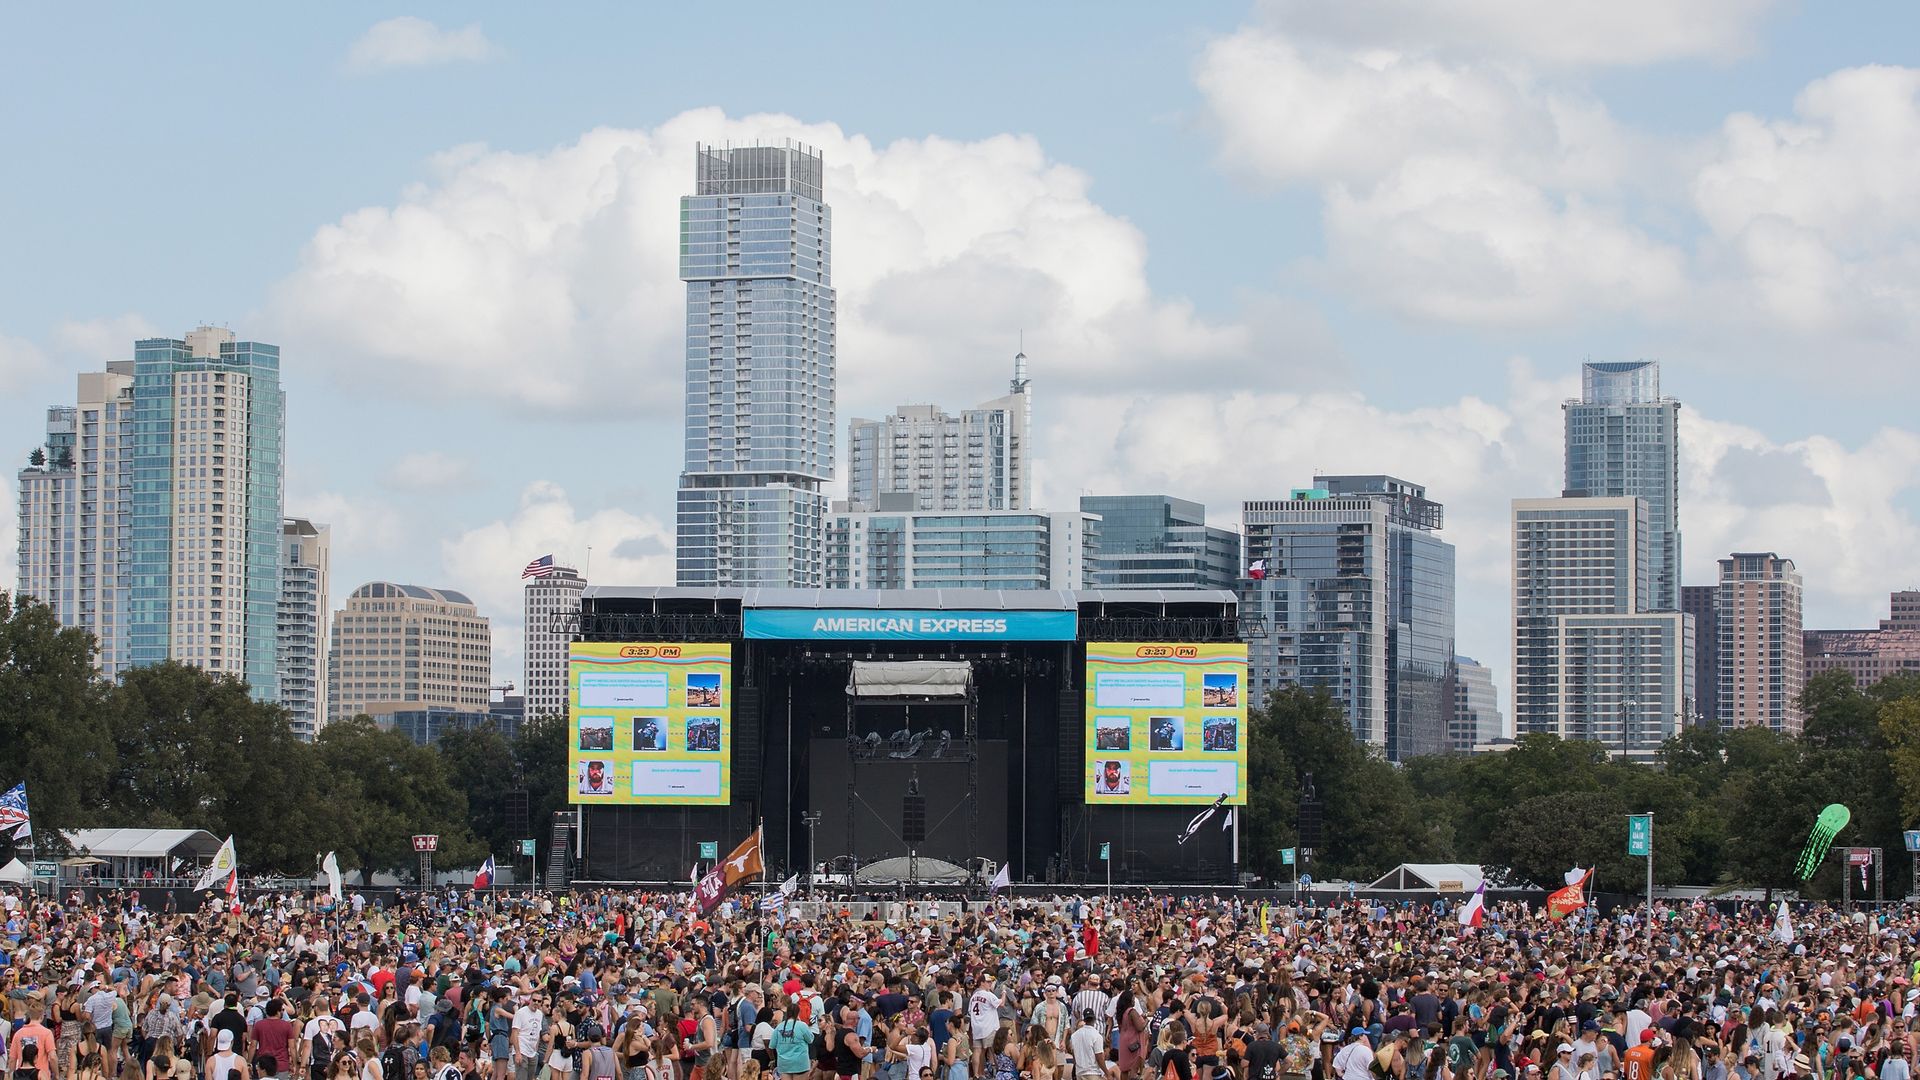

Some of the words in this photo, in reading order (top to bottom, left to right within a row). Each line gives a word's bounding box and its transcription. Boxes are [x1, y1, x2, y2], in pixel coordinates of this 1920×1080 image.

[813, 618, 914, 632] AMERICAN
[919, 618, 1007, 633] EXPRESS
[973, 1003, 980, 1016] 4
[1765, 1040, 1771, 1054] 1
[1629, 1061, 1639, 1080] 18
